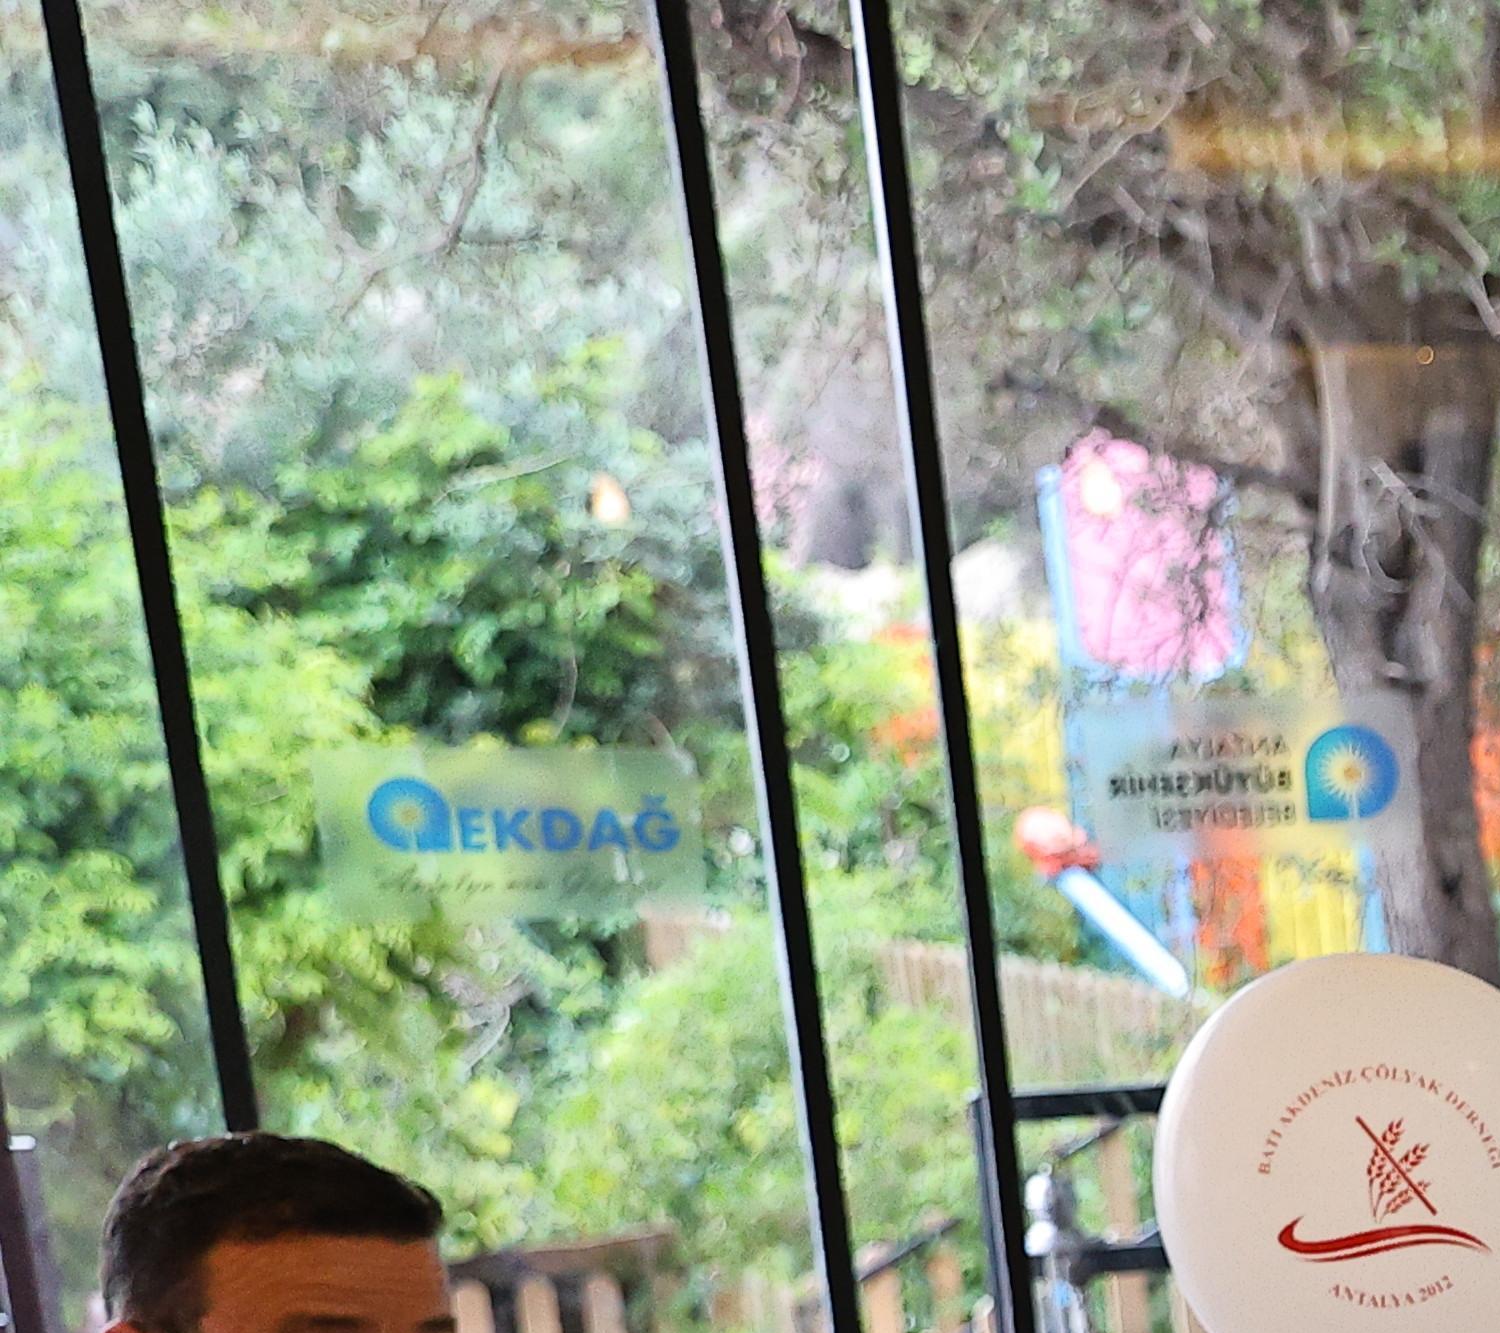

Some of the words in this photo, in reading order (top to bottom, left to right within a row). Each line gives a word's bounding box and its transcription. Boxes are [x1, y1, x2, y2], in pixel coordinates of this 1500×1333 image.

[457, 795, 681, 853] EKDAĞ
[1279, 1066, 1357, 1123] AKDENİZ
[1360, 1062, 1442, 1096] ÇÖLYAK
[1328, 1284, 1415, 1309] ANTALYA
[1419, 1275, 1454, 1302] 2012
